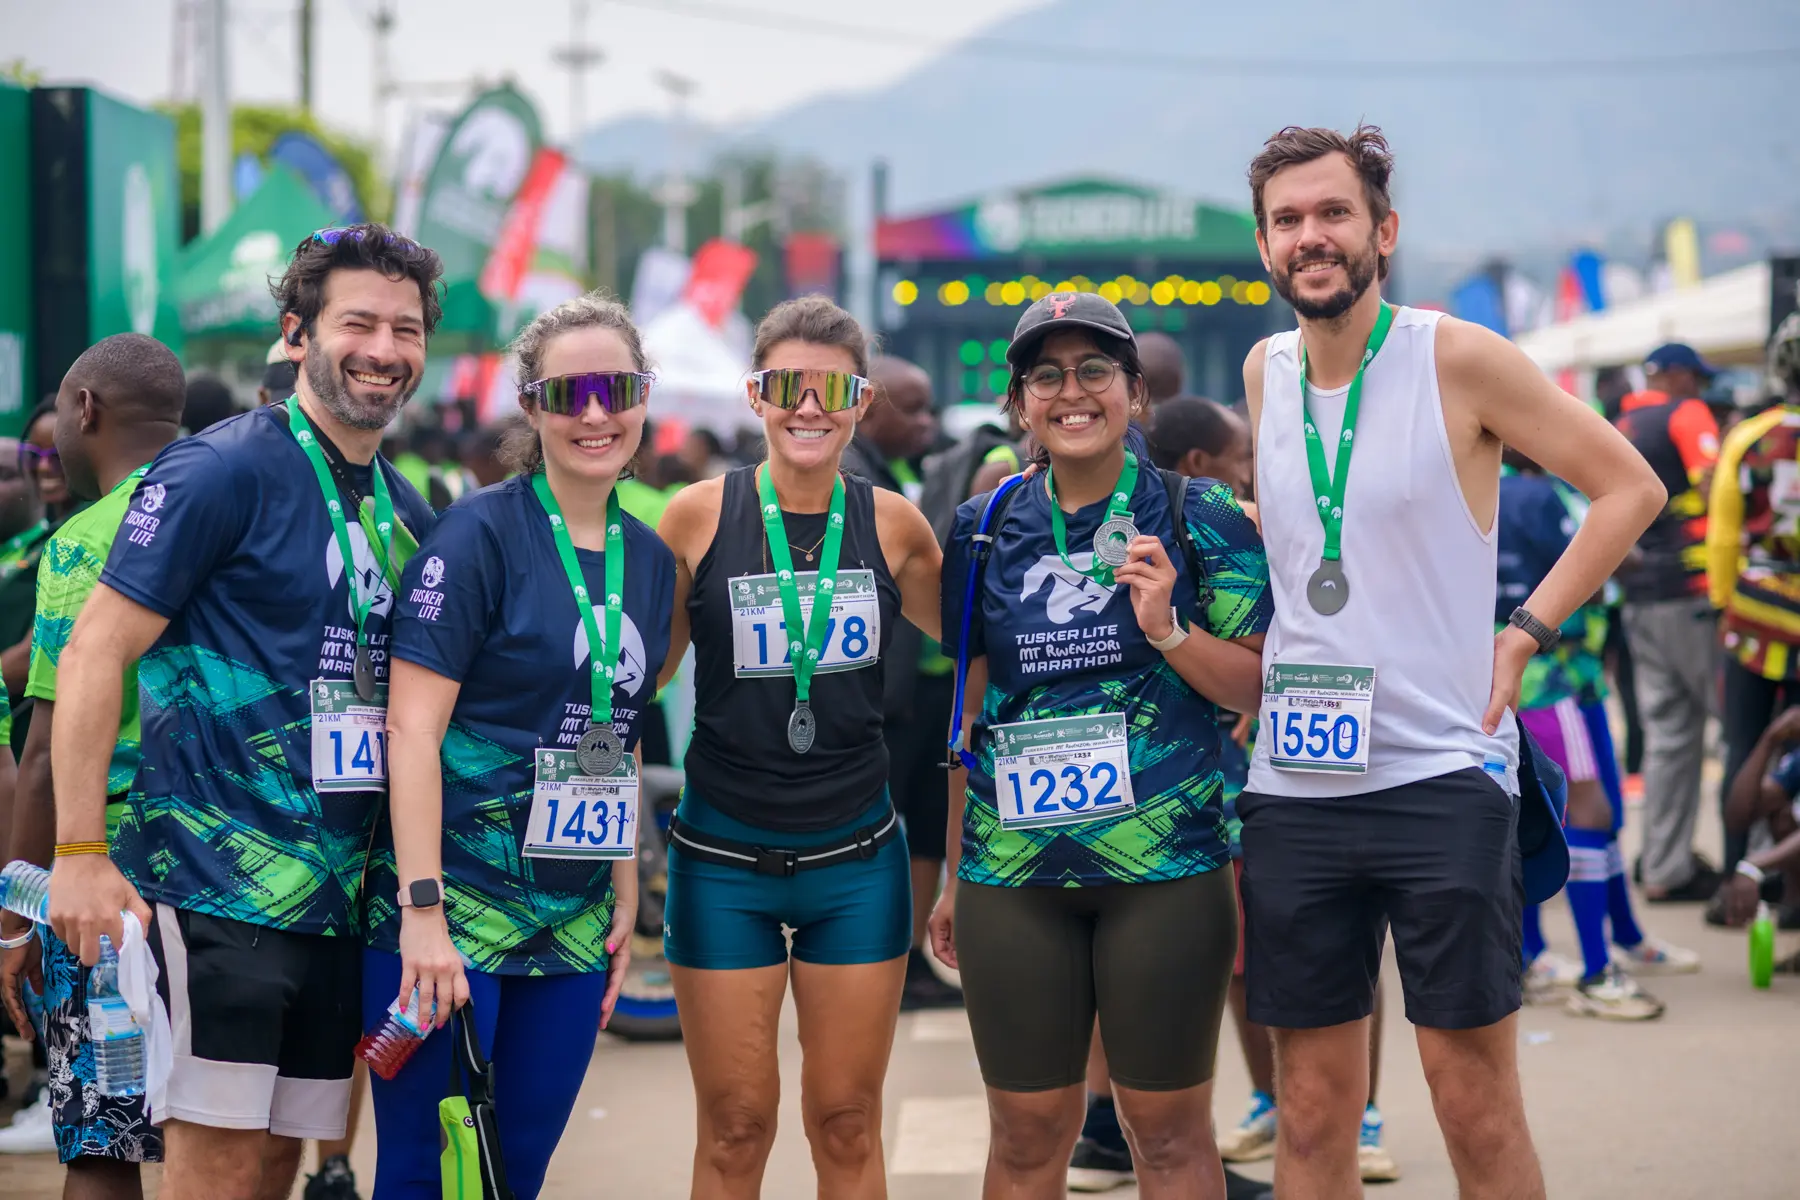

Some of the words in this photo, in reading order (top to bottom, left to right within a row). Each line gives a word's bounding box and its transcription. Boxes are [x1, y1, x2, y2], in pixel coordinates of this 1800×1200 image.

[125, 510, 160, 532] TUSKER
[128, 528, 155, 547] LITE
[410, 589, 444, 606] TUSKER
[738, 593, 755, 602] TUSKER
[418, 605, 441, 621] LITE
[740, 607, 765, 616] 21KM
[1016, 629, 1079, 645] TUSKER
[1083, 624, 1118, 639] LITE
[320, 641, 343, 656] MT
[1019, 647, 1041, 661] MT
[1022, 653, 1122, 674] MARATHON
[614, 708, 638, 720] LITE
[560, 717, 582, 731] MT
[1270, 711, 1359, 760] 1550
[998, 757, 1018, 766] 21KM
[540, 783, 561, 791] 21KM
[1008, 762, 1122, 815] 1232
[545, 799, 626, 845] 1431
